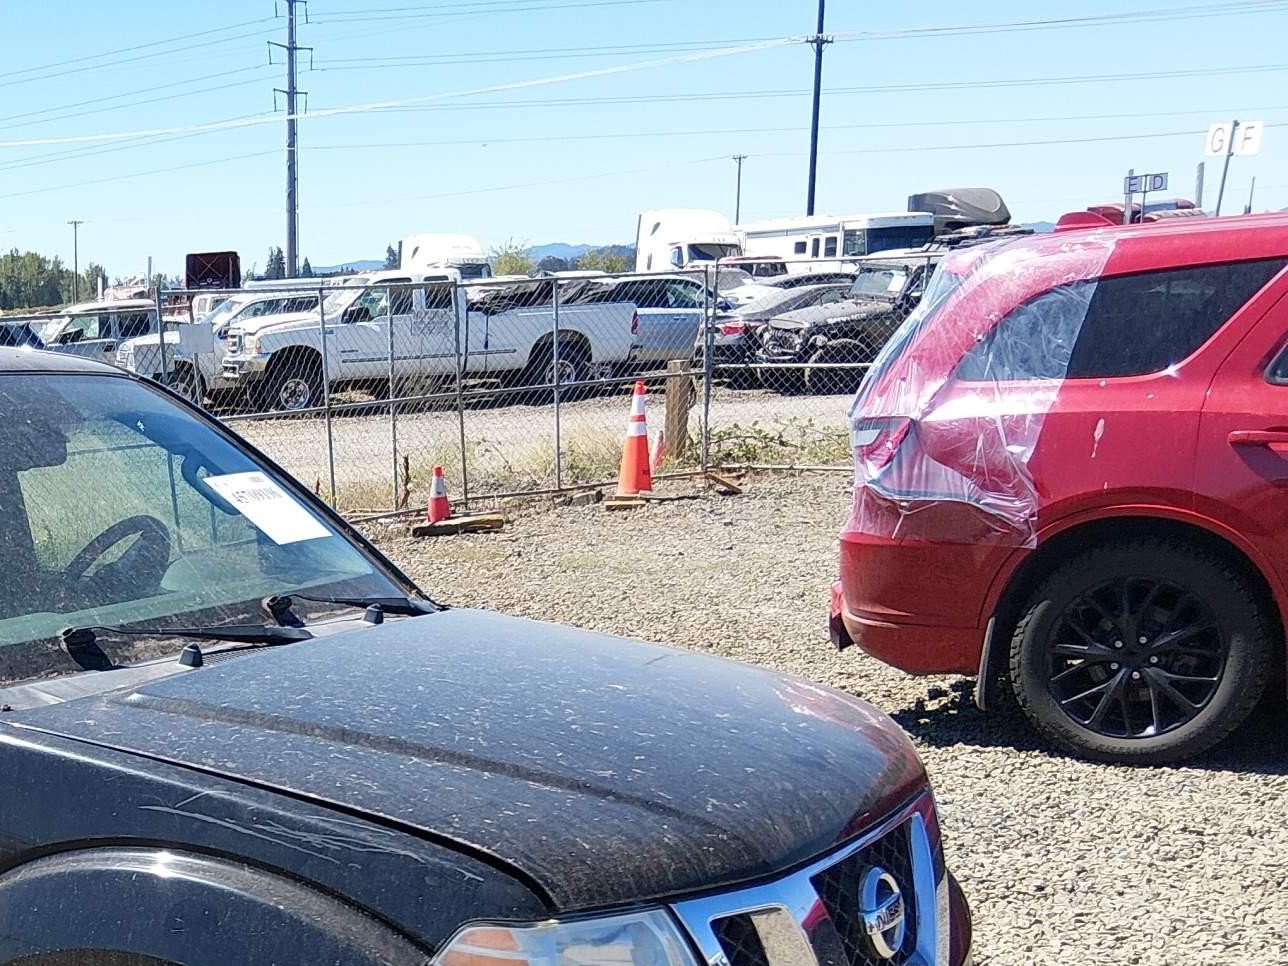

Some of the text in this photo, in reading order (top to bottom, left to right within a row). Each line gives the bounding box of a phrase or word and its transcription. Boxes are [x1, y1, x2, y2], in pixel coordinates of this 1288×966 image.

[1211, 127, 1225, 153] G
[1240, 125, 1255, 151] F
[1128, 175, 1138, 193] E
[1153, 175, 1164, 190] D
